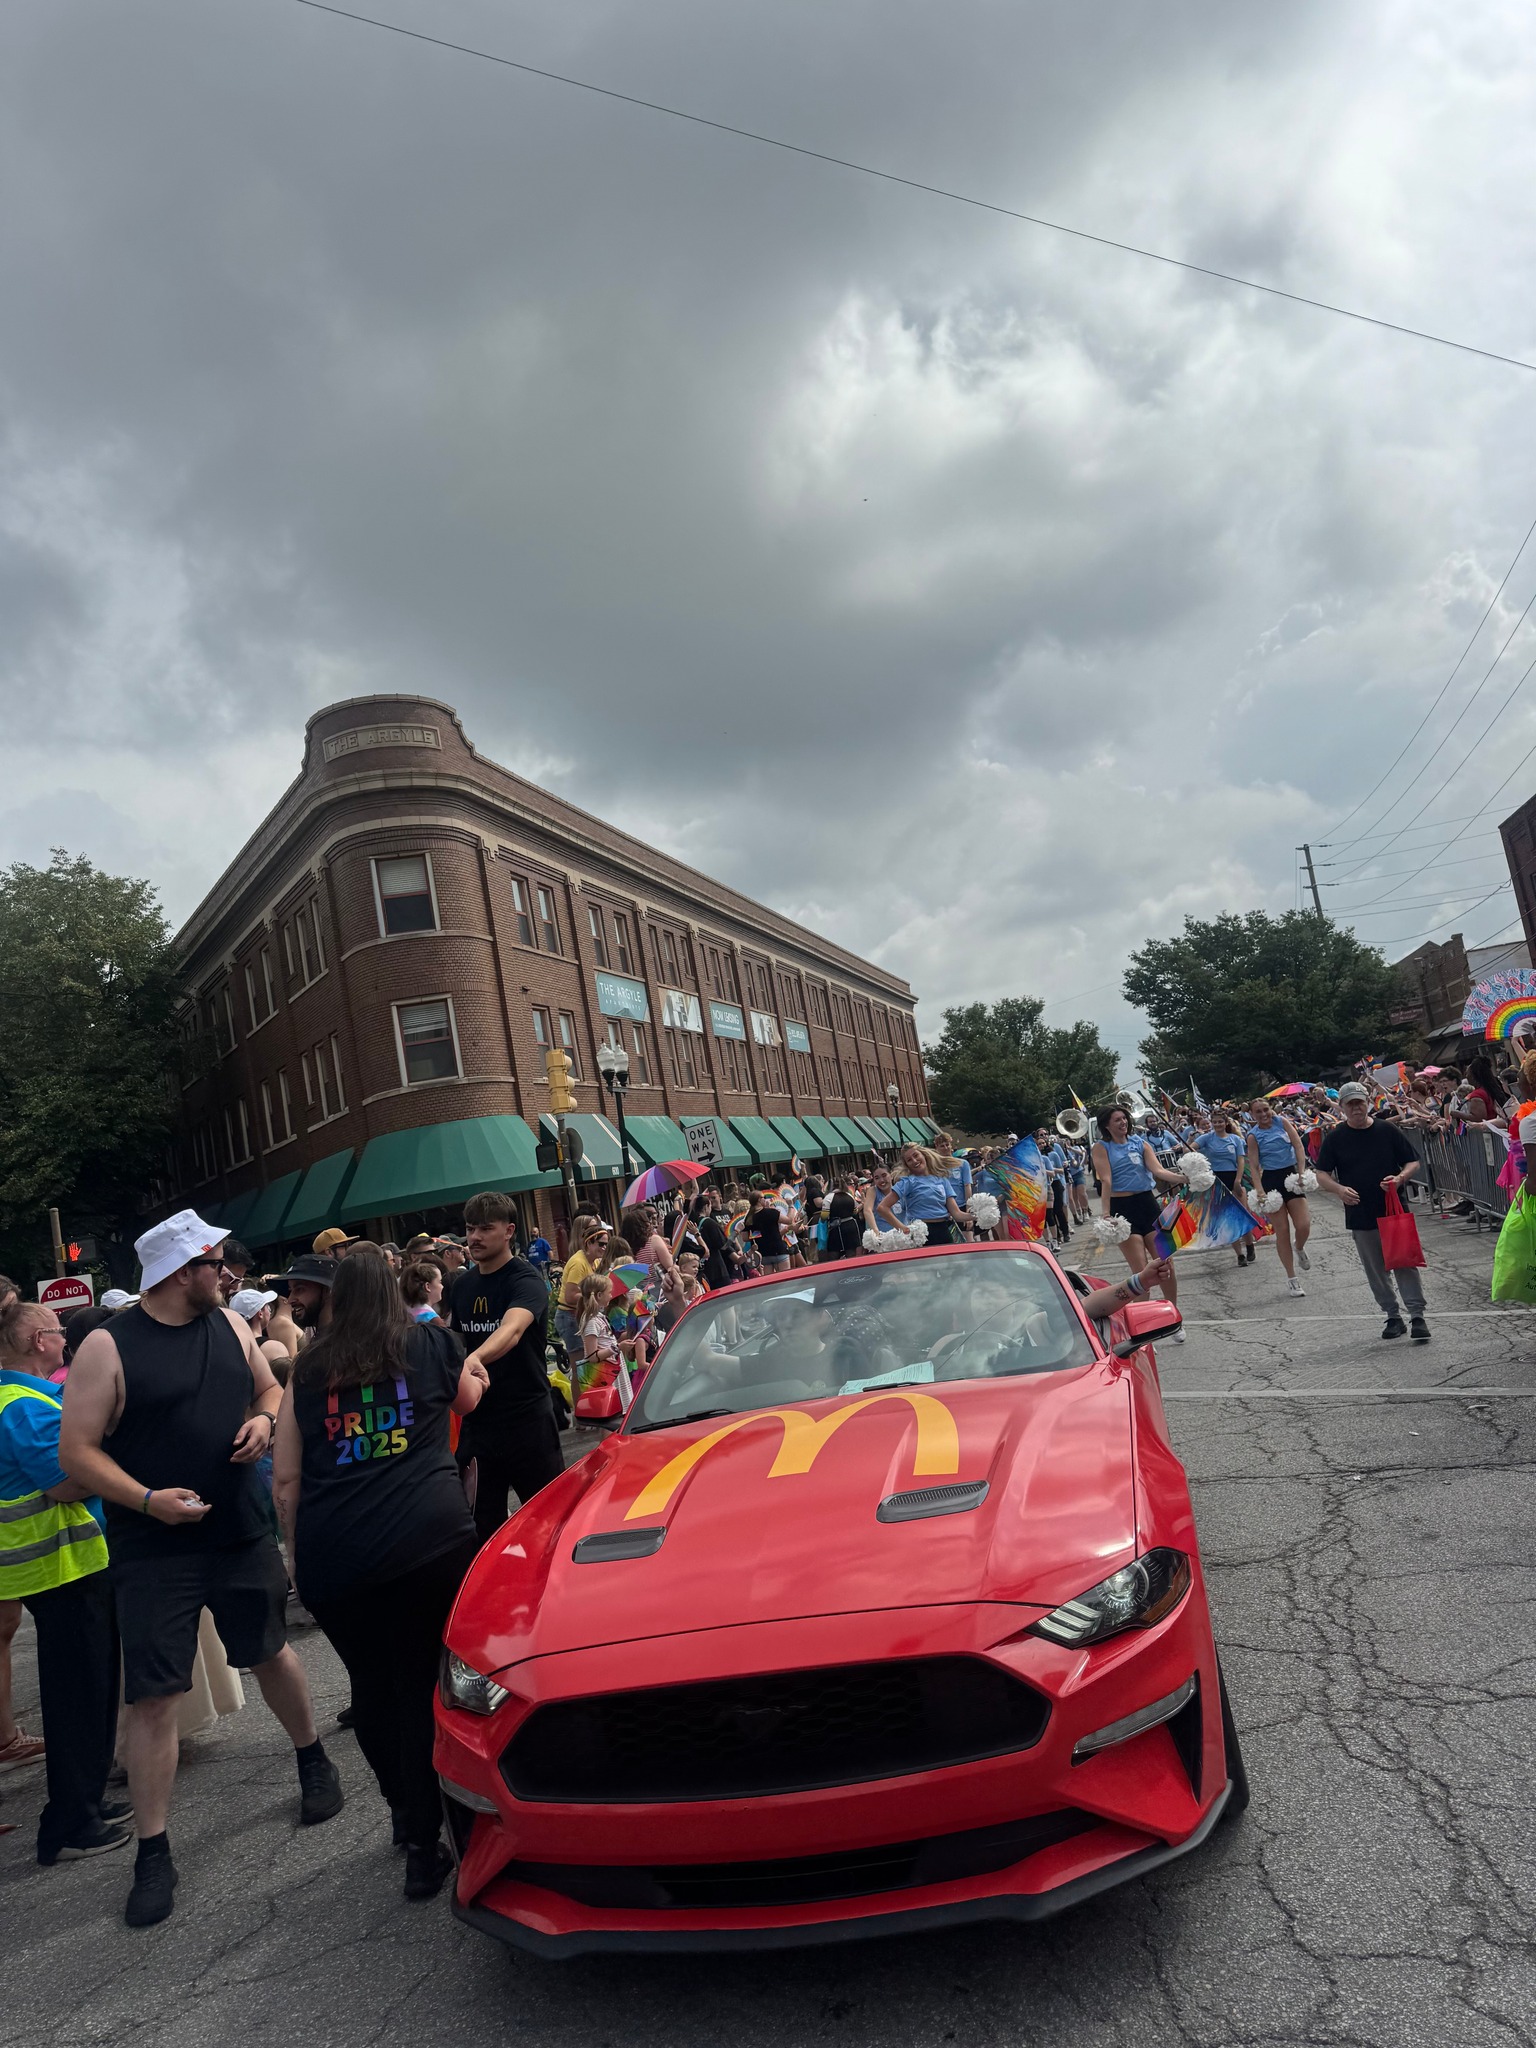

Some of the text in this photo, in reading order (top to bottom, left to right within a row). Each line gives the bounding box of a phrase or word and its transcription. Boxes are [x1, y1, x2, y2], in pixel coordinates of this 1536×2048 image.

[328, 728, 434, 755] THE ARGYLE
[599, 982, 642, 1003] THE ARGYLE
[712, 1009, 724, 1022] NOW
[689, 1125, 713, 1141] ONE
[691, 1138, 715, 1154] WAY
[47, 1285, 84, 1299] DO NOT
[324, 1401, 415, 1441] PRIDE
[335, 1428, 408, 1466] 2025
